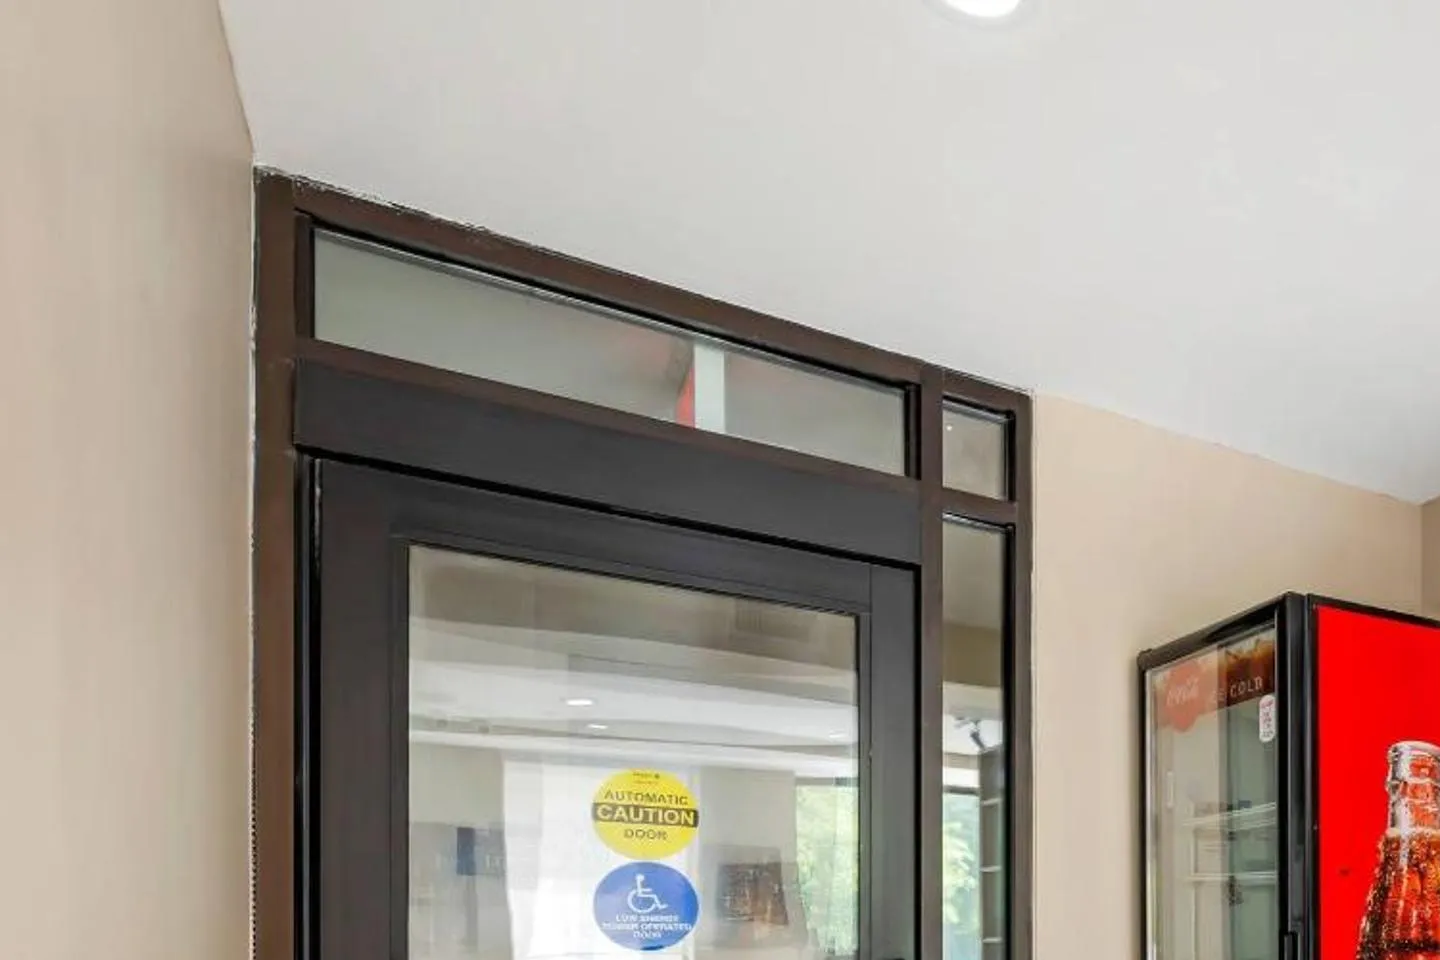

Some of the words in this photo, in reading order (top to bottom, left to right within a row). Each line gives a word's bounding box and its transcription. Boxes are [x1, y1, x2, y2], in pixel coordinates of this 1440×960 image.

[1230, 676, 1263, 698] COLD
[604, 790, 689, 805] AUTOMATIC
[597, 804, 695, 825] CAUTION
[624, 828, 668, 840] DOOR
